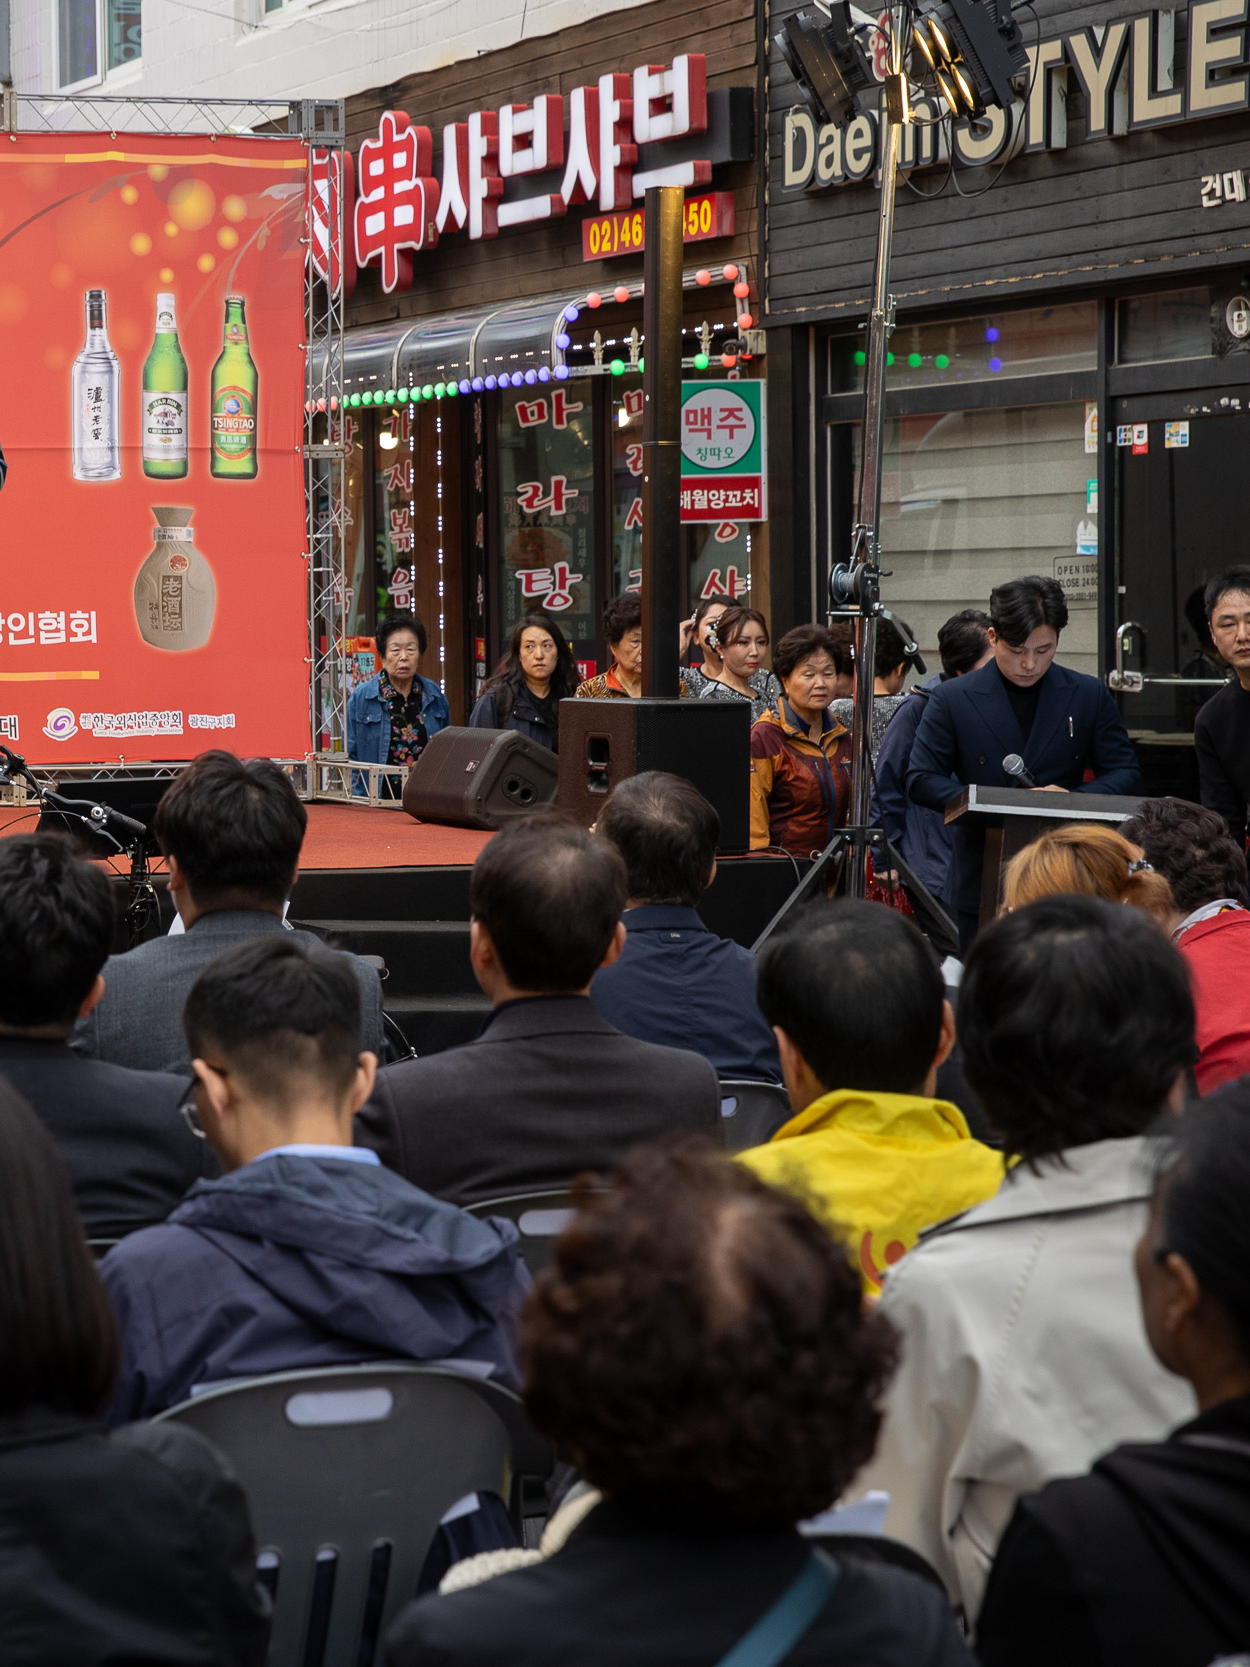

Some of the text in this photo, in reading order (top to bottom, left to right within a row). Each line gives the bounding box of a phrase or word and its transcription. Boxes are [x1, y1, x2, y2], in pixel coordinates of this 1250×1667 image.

[435, 53, 702, 241] 샤브샤브
[213, 417, 254, 430] TSINGTAO
[684, 406, 747, 440] 맥주
[695, 446, 735, 462] 칭따오
[515, 388, 583, 611] 마라탕
[1057, 565, 1080, 576] OPEN
[93, 711, 235, 729] 한국외식업중앙회 광진구지회
